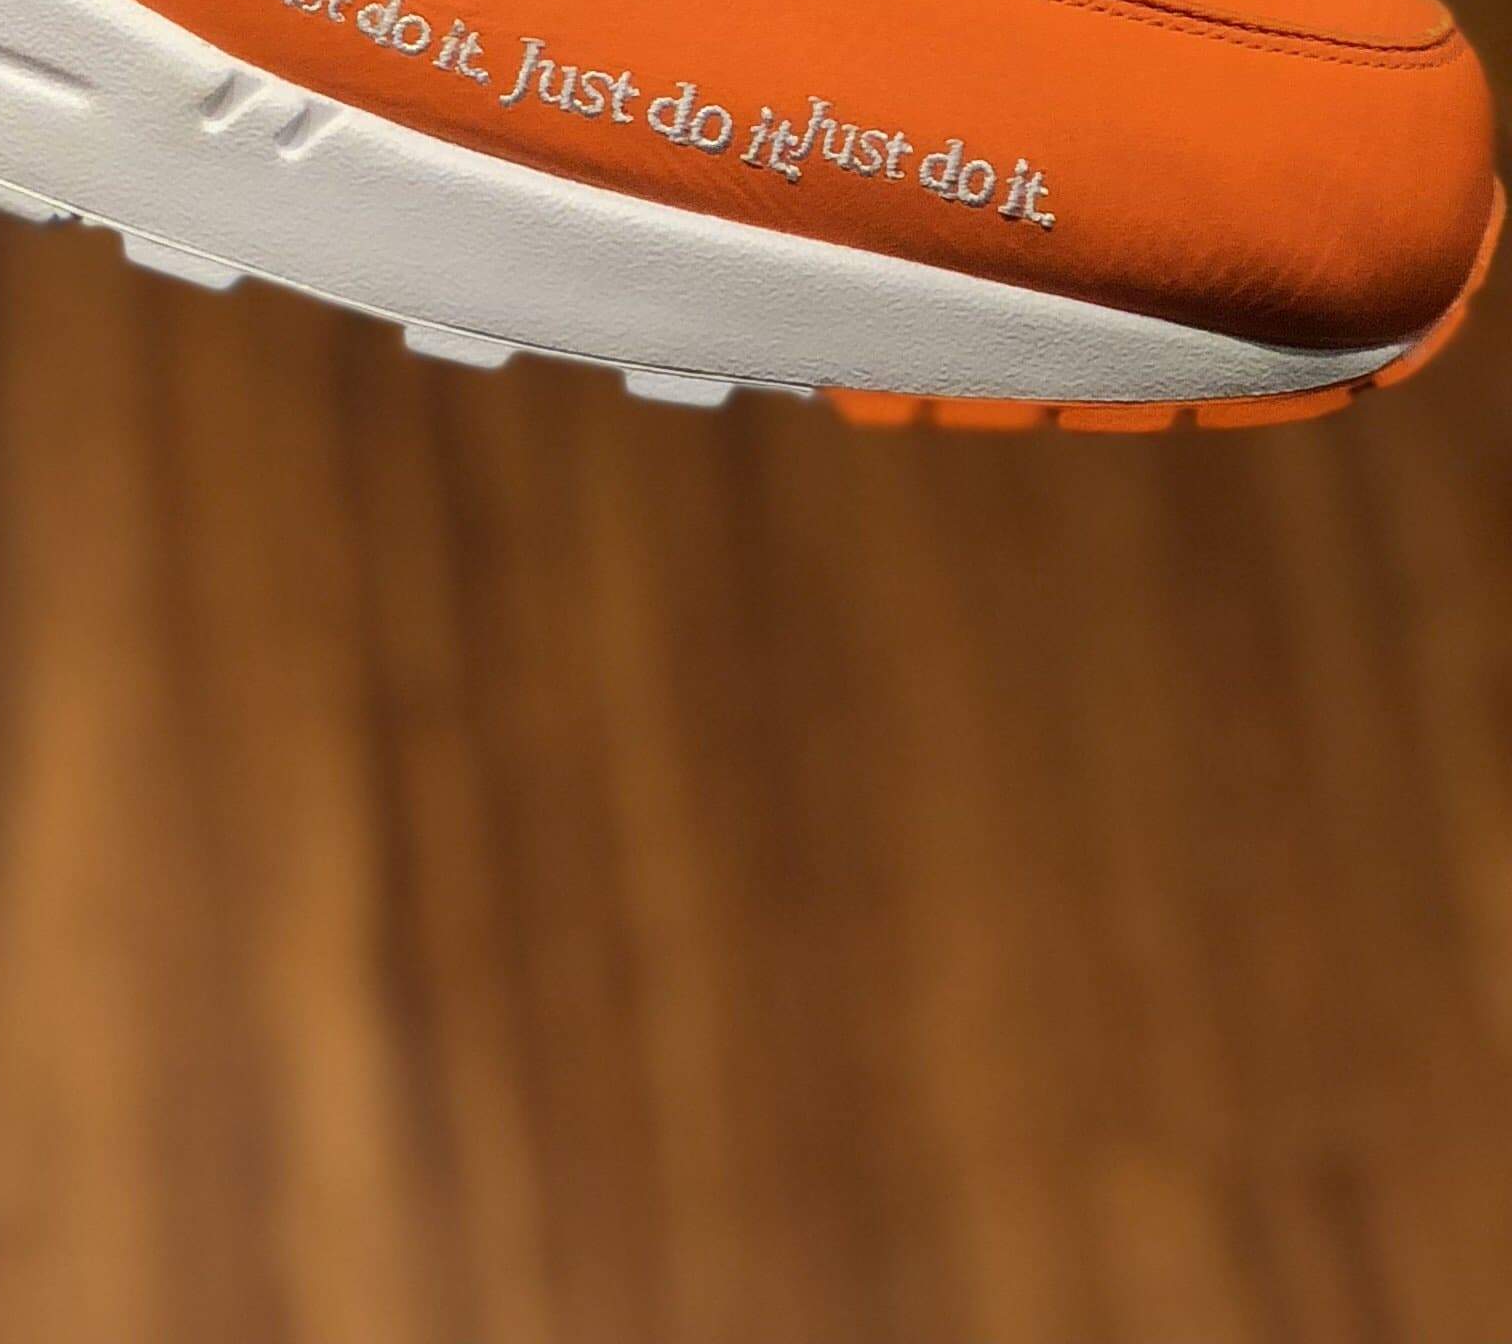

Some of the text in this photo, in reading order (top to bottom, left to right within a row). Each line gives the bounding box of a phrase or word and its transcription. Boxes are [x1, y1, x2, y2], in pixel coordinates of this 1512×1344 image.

[432, 17, 492, 86] it.
[498, 36, 641, 124] Just
[646, 80, 734, 155] do
[787, 94, 914, 180] Just
[917, 138, 997, 207] do
[997, 157, 1057, 229] it.
